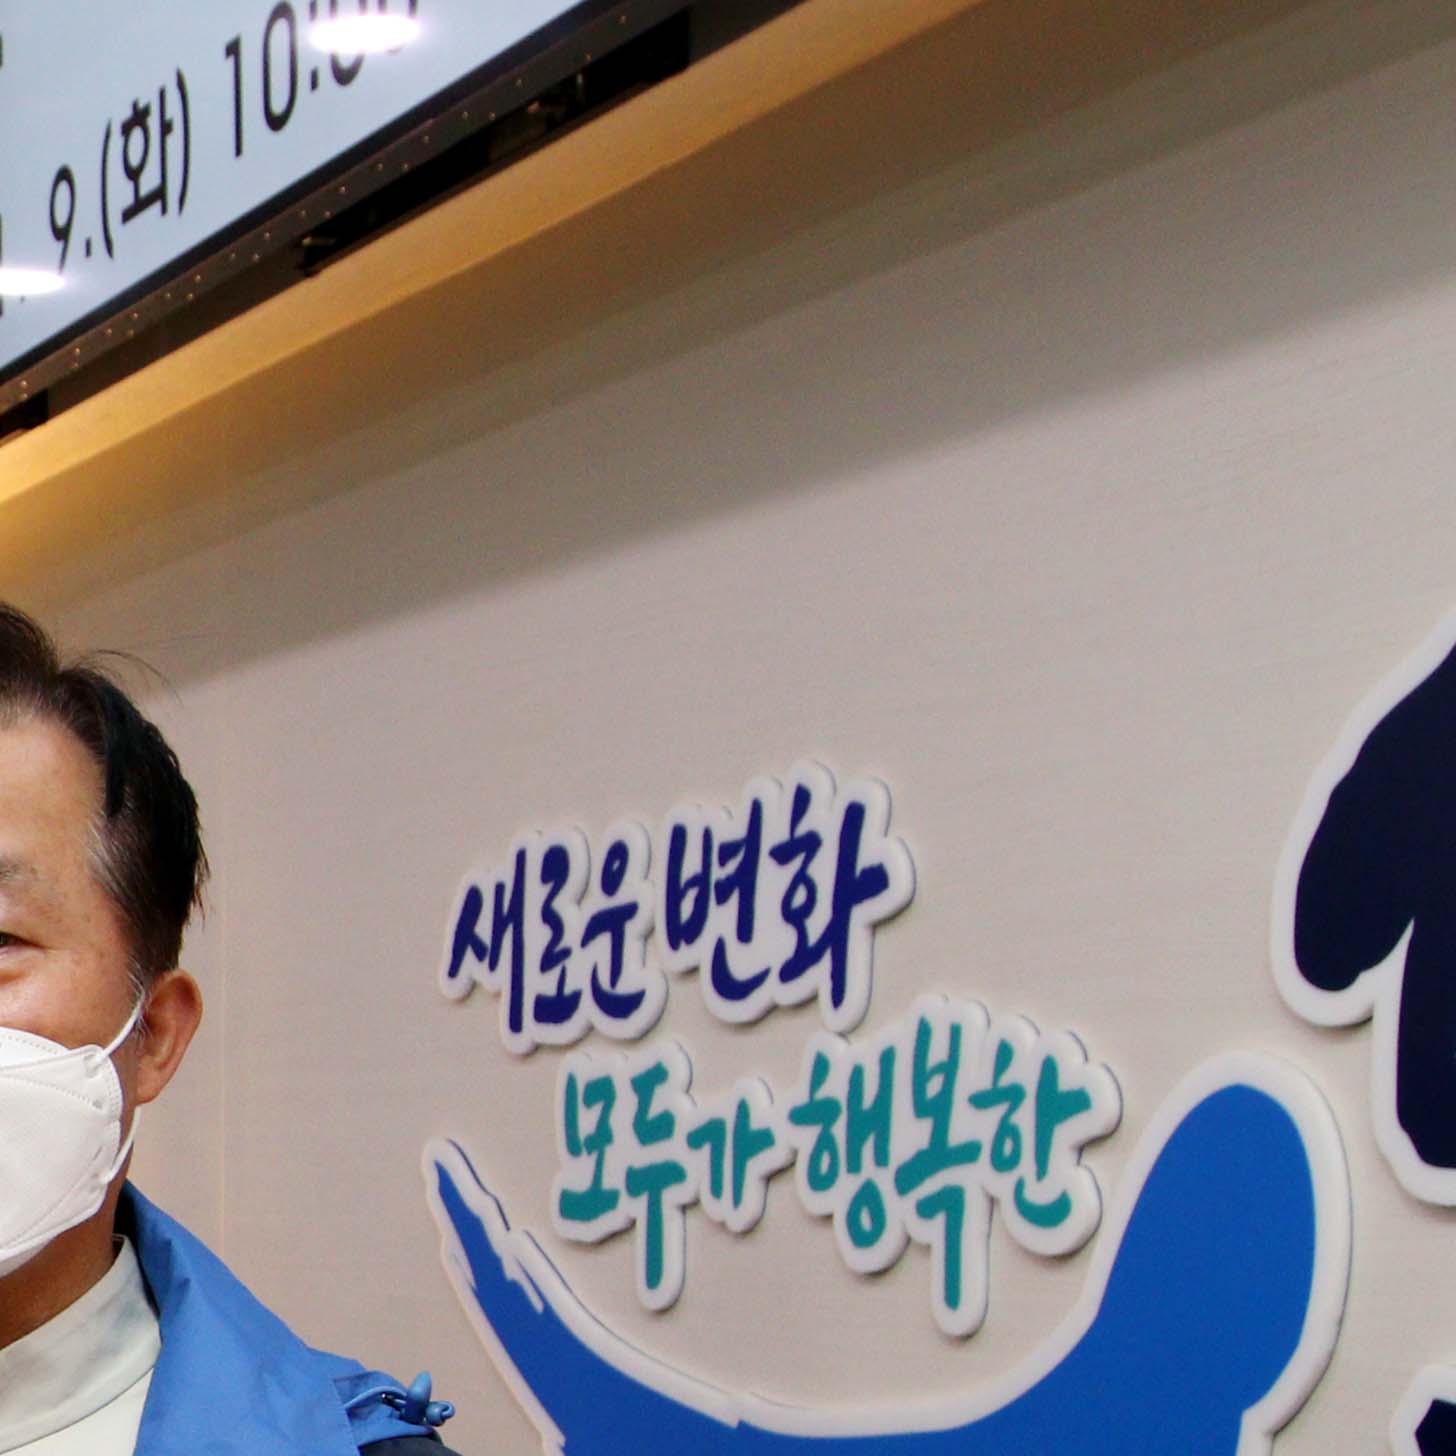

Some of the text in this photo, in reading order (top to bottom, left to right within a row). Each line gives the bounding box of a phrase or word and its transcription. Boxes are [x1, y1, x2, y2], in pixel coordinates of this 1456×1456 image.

[448, 782, 889, 1034] 새로운 변화
[556, 1014, 1093, 1312] 모두가 행복한
